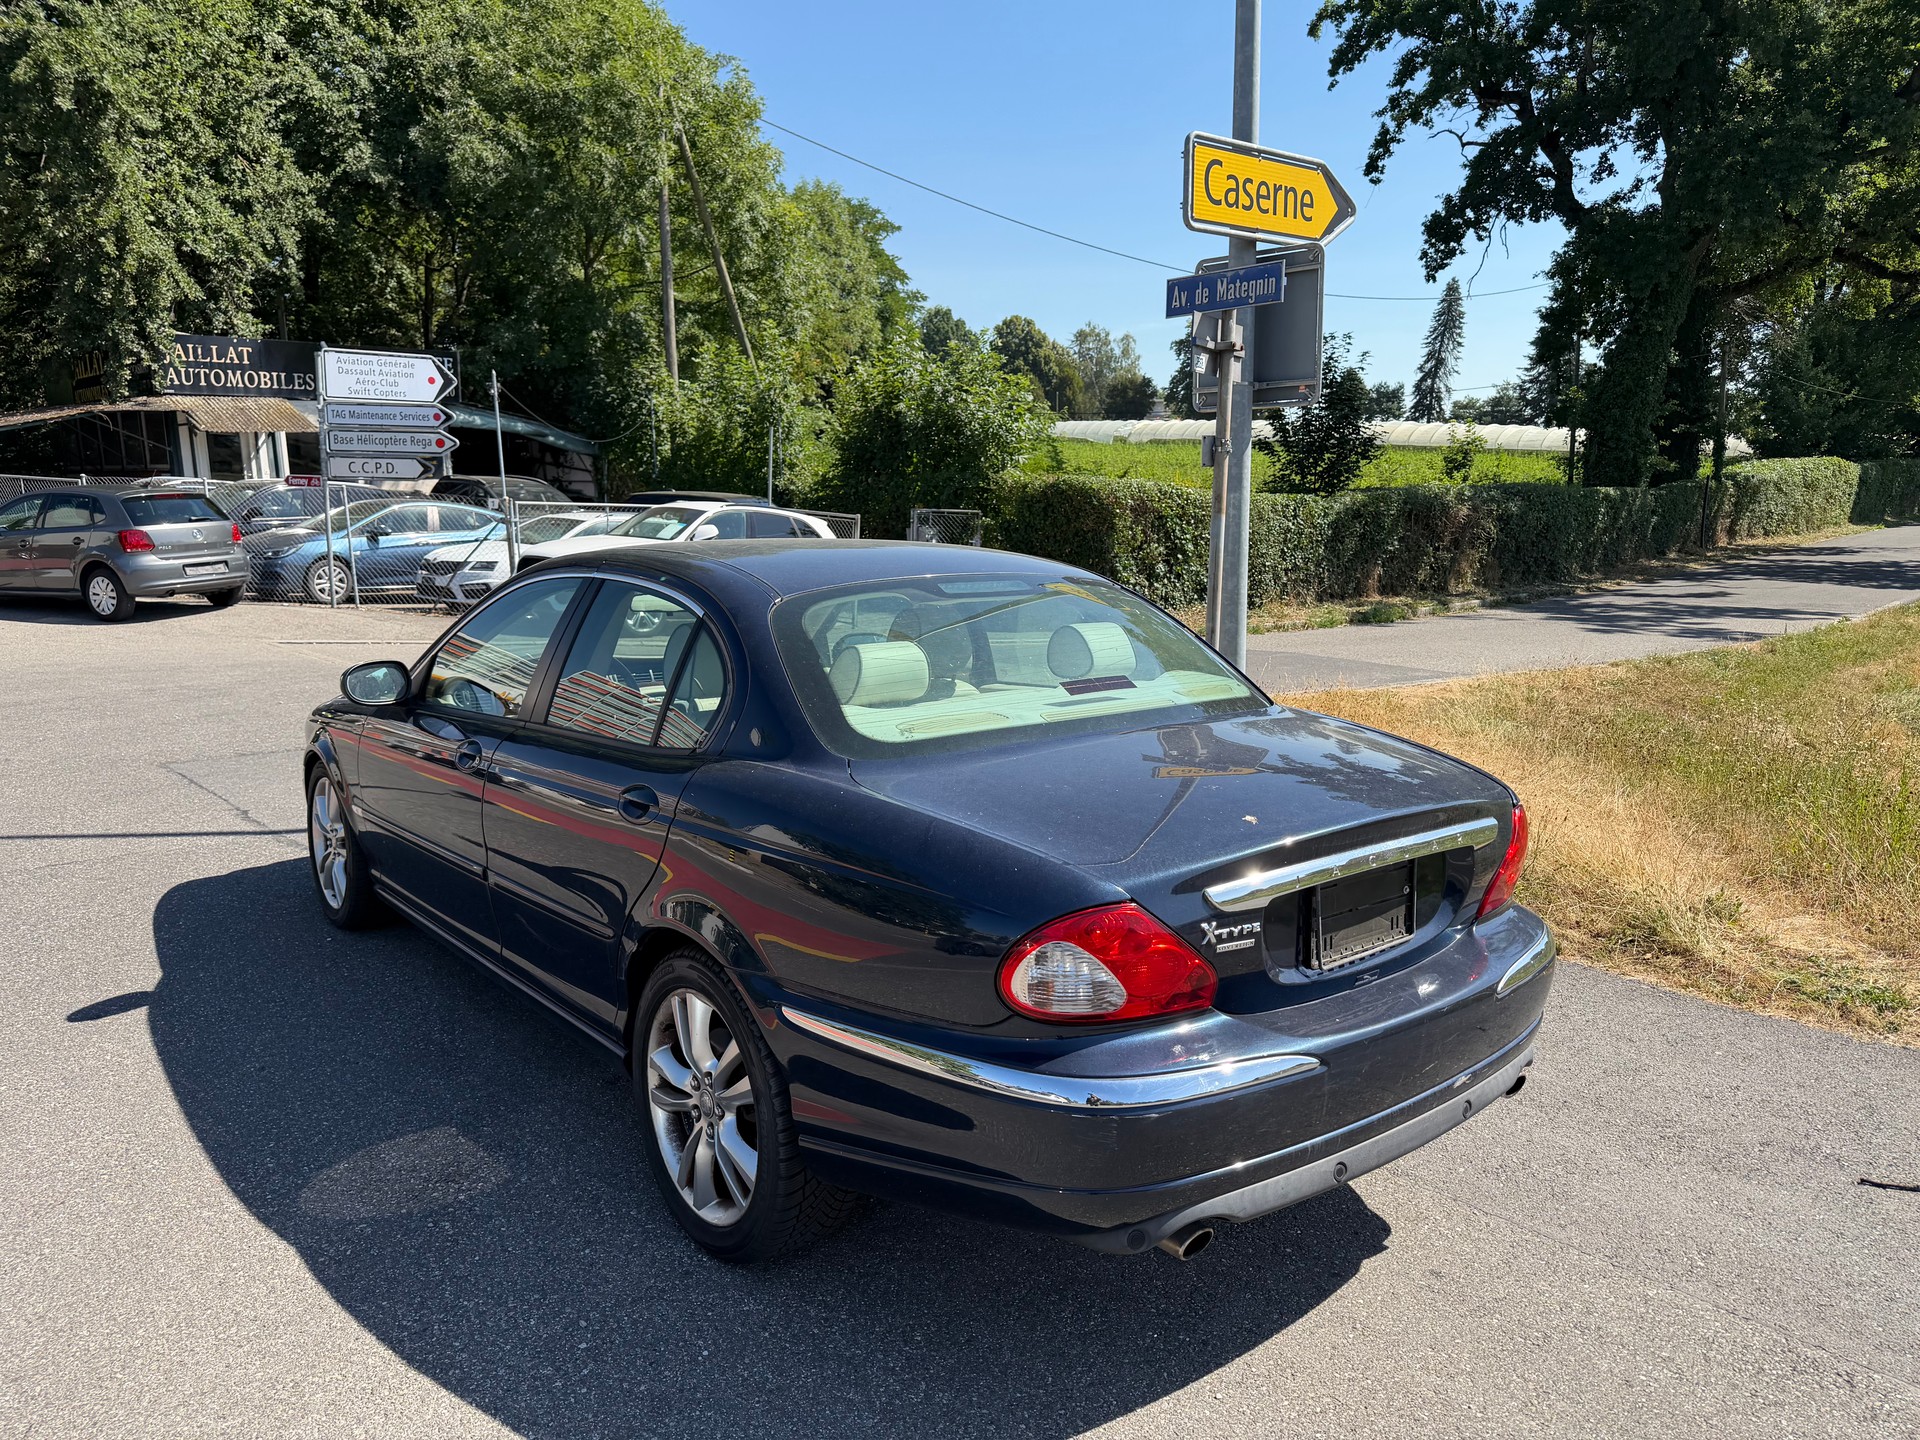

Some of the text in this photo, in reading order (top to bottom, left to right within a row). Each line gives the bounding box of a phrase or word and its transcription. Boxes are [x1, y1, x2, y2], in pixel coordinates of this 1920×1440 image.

[1204, 159, 1315, 222] Caserne
[1171, 273, 1276, 309] Av. de Mategnin
[336, 356, 416, 370] Aviation Générale
[166, 367, 316, 391] AUTOMOBILES
[337, 366, 415, 379] Dassault Aviation
[355, 377, 399, 388] Aéro-Club
[347, 386, 407, 398] Swift Copters
[330, 409, 430, 422] TAG Maintenance Services
[333, 434, 432, 449] Base Hélicoptère Rega
[348, 461, 399, 474] C.C.P.D.
[288, 476, 309, 487] Ferney
